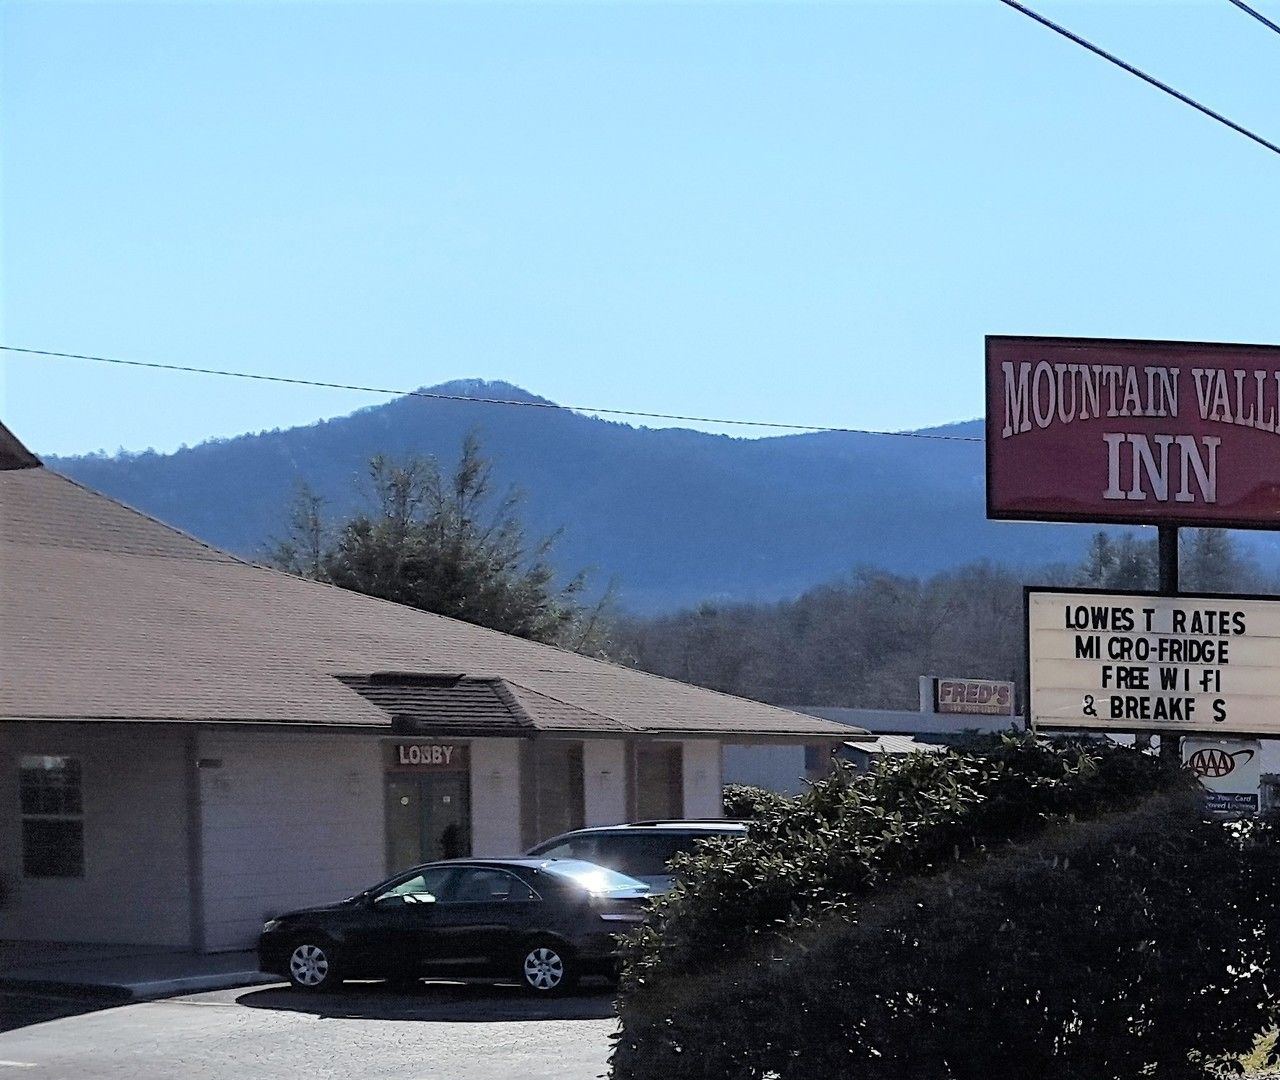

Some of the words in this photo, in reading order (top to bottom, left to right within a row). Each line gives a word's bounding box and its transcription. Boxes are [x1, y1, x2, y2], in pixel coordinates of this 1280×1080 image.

[1001, 361, 1180, 438] MOUNTAIN
[1103, 432, 1222, 503] INN
[1172, 609, 1246, 636] RATES
[1074, 635, 1229, 664] MICRO-FRIDGE
[1101, 665, 1150, 690] FREE
[940, 682, 1009, 705] FRED'S
[1083, 694, 1097, 717] &
[400, 745, 453, 764] LOBBY
[1193, 749, 1232, 777] AAA
